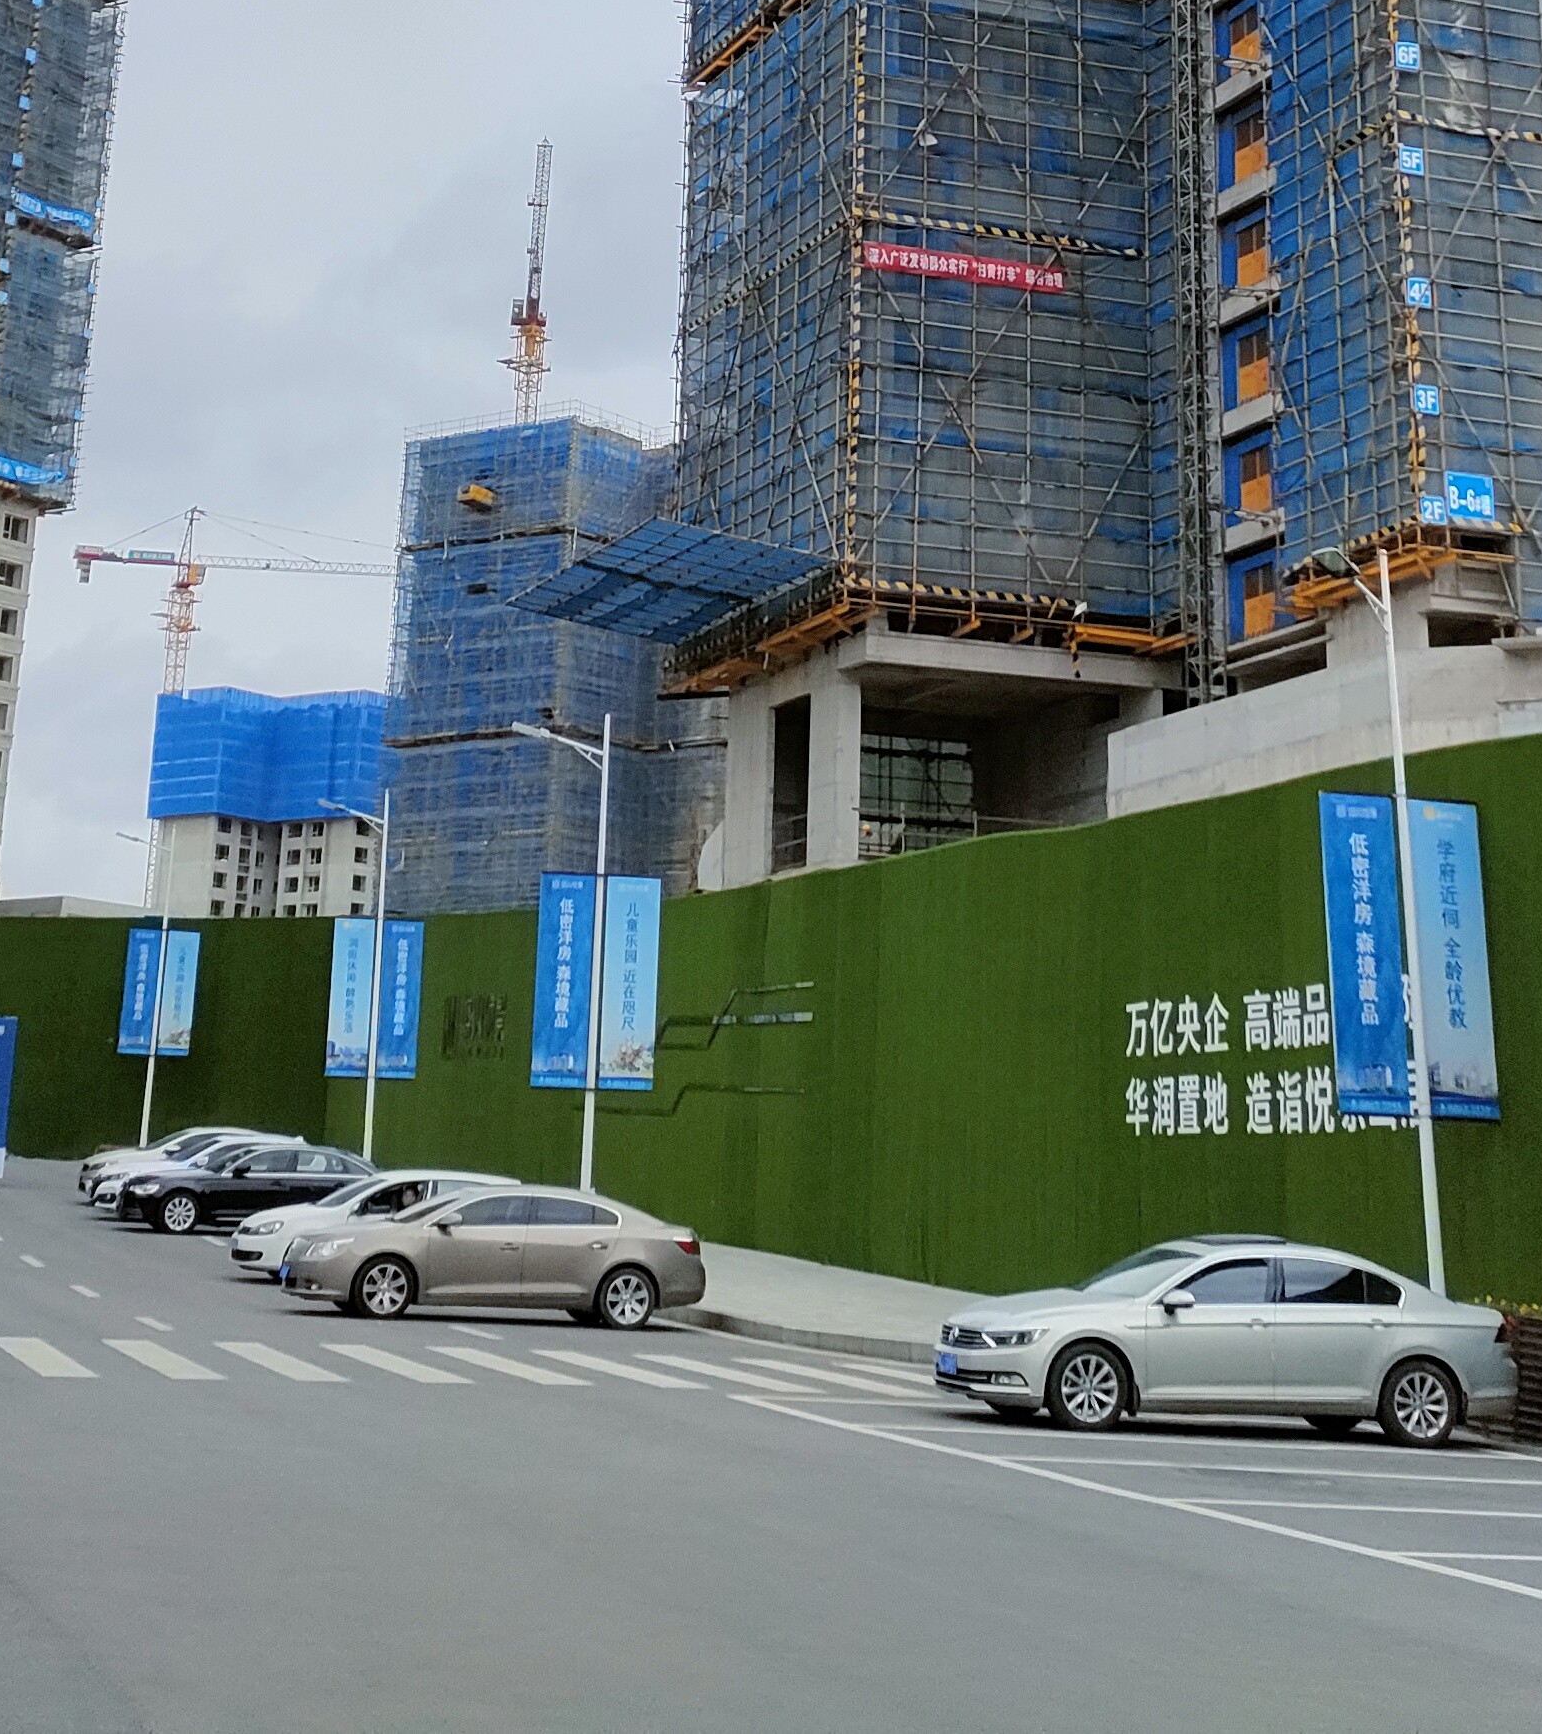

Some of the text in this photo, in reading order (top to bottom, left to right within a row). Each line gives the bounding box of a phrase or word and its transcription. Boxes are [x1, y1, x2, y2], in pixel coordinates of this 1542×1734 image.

[1398, 46, 1418, 65] 6F
[1402, 151, 1422, 170] 5F
[1417, 389, 1437, 409] 3F
[1423, 500, 1444, 520] 2F
[1349, 832, 1373, 926] 低密洋房
[557, 897, 575, 962] 低密洋房
[624, 902, 639, 964] 儿童乐园
[621, 968, 636, 1031] 近在咫尺
[1125, 992, 1230, 1058] 万亿央企
[1125, 1071, 1229, 1137] 华润置地
